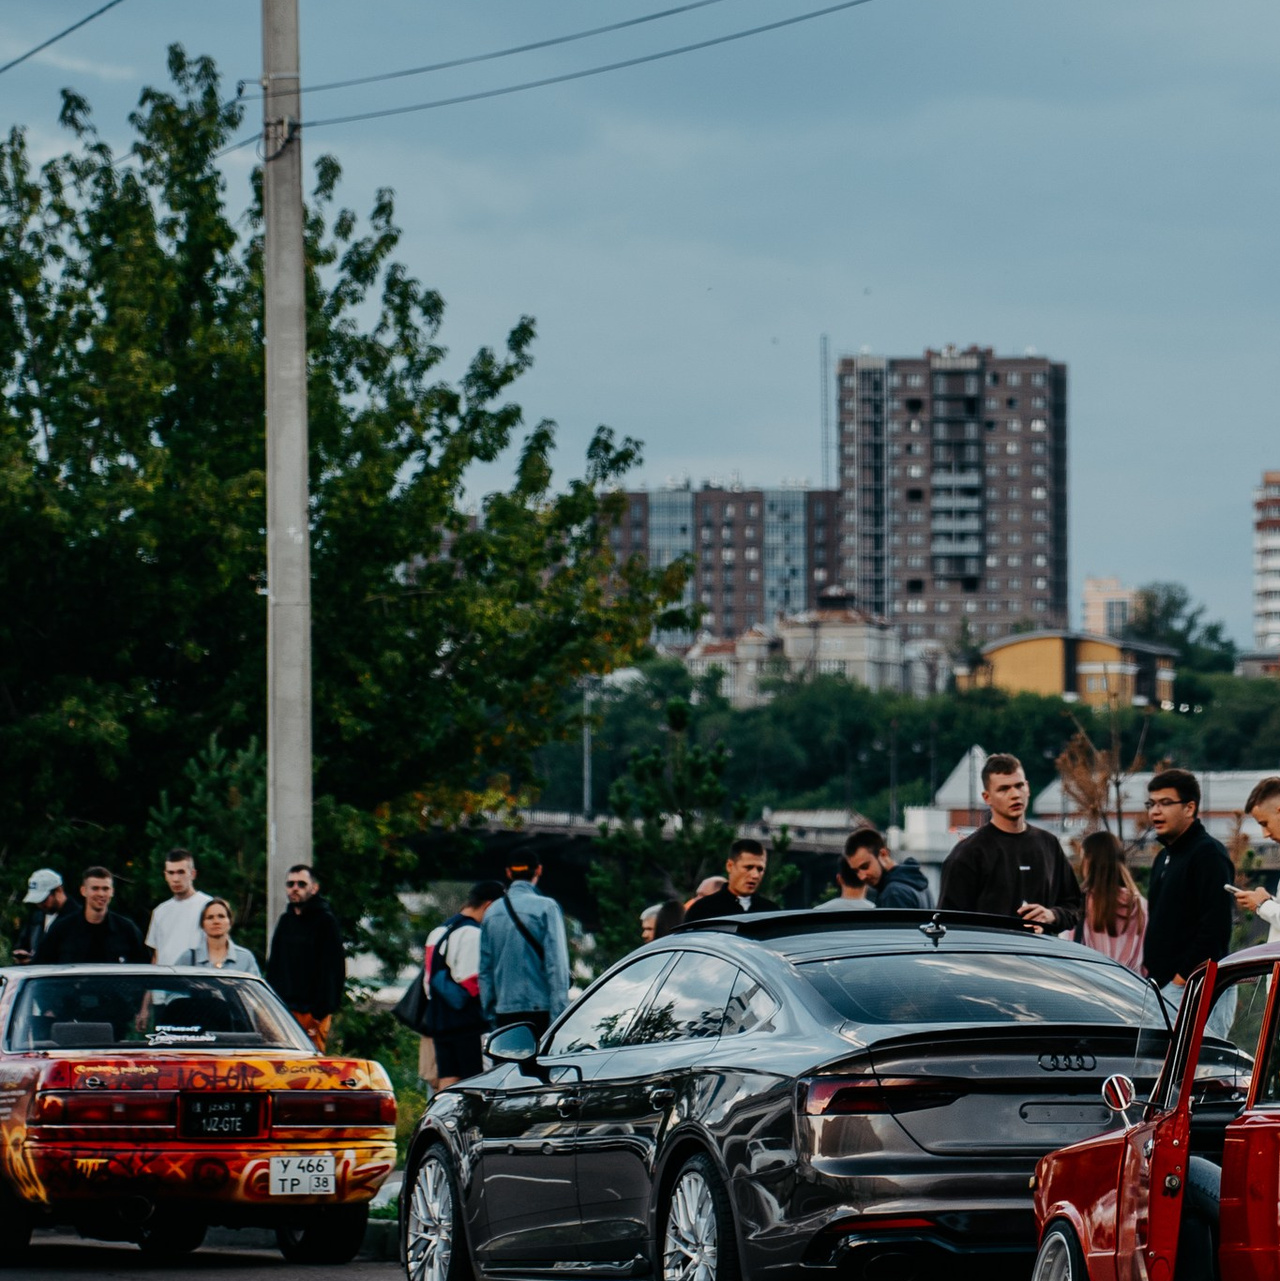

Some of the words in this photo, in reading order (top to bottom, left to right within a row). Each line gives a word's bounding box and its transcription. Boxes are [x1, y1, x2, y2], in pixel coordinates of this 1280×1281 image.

[202, 1117, 243, 1131] 1JZ-GTE
[297, 1159, 325, 1173] 466
[278, 1178, 301, 1192] ТР
[314, 1176, 329, 1188] 38
